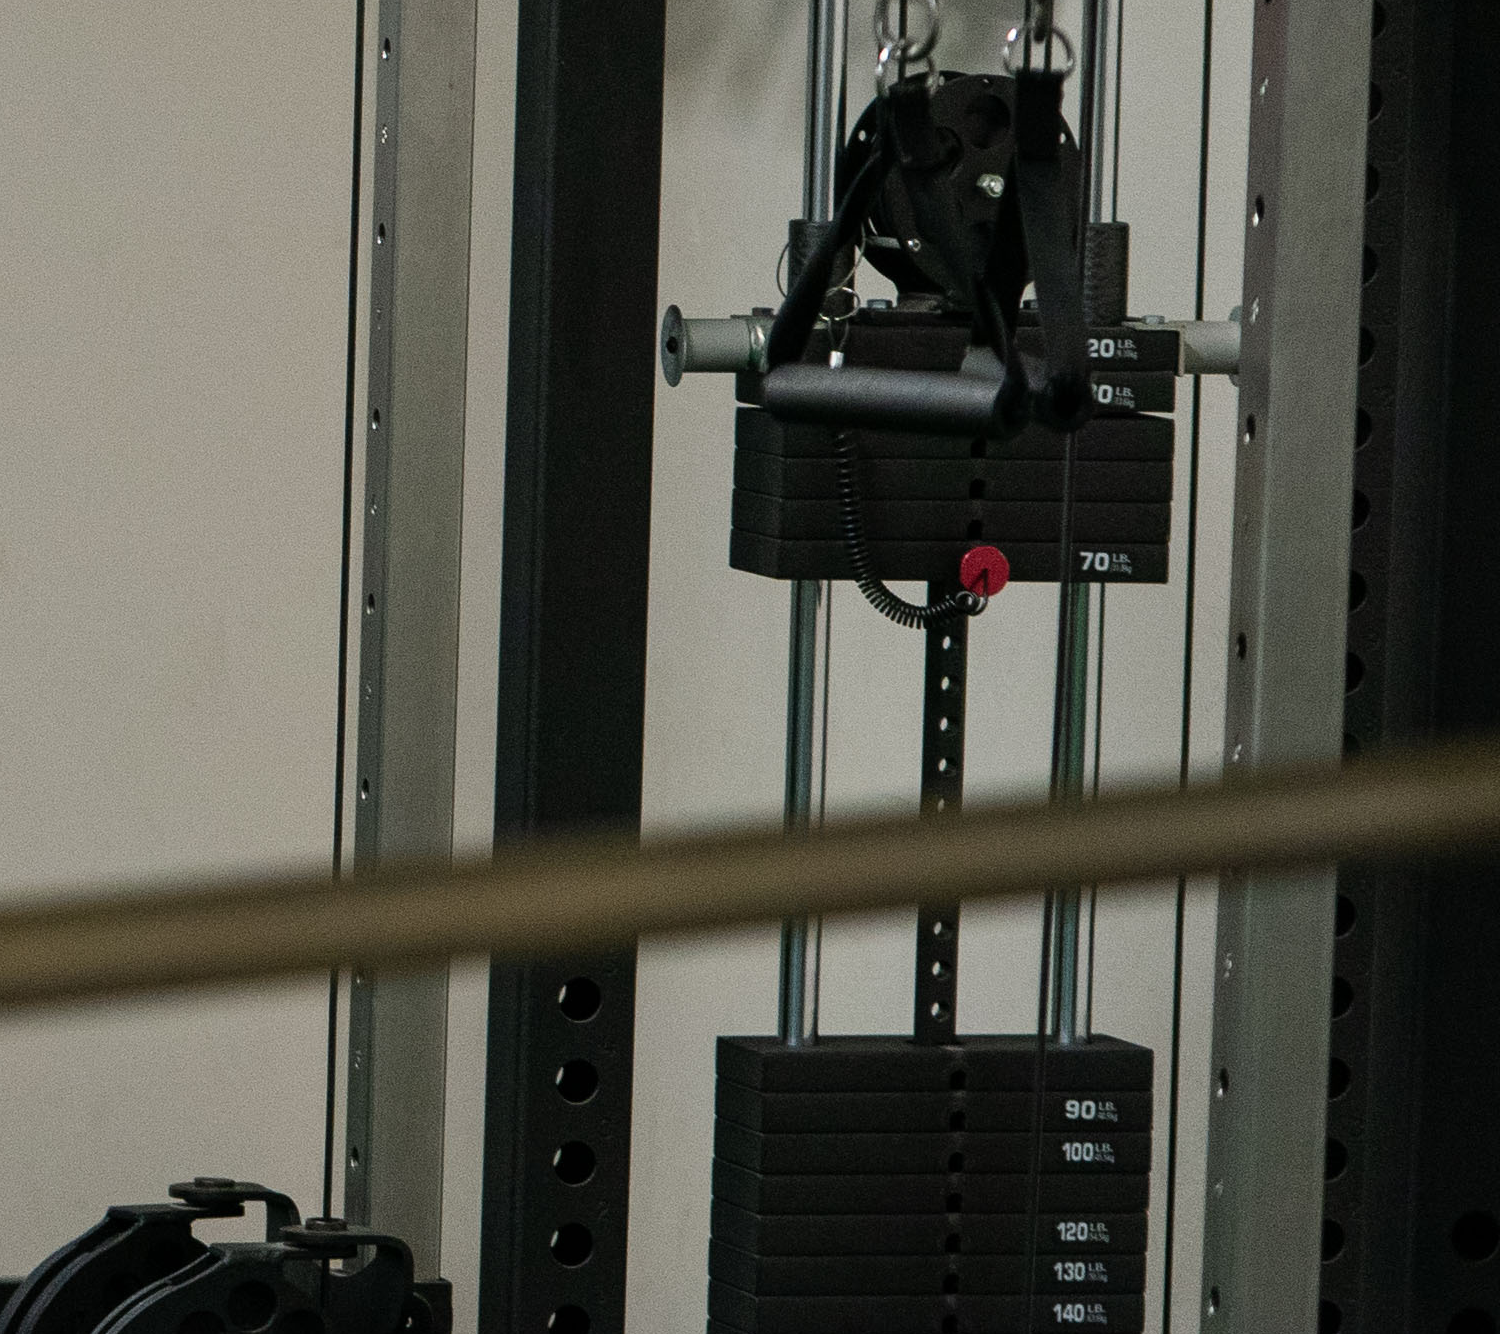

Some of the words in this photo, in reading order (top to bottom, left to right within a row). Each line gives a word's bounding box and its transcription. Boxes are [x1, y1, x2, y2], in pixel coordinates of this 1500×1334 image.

[1087, 338, 1115, 358] 20
[1080, 551, 1110, 571] 70
[1065, 1100, 1096, 1120] 90
[1062, 1142, 1094, 1162] 100
[1056, 1221, 1088, 1242] 120
[1054, 1262, 1086, 1282] 130
[1053, 1303, 1085, 1323] 140
